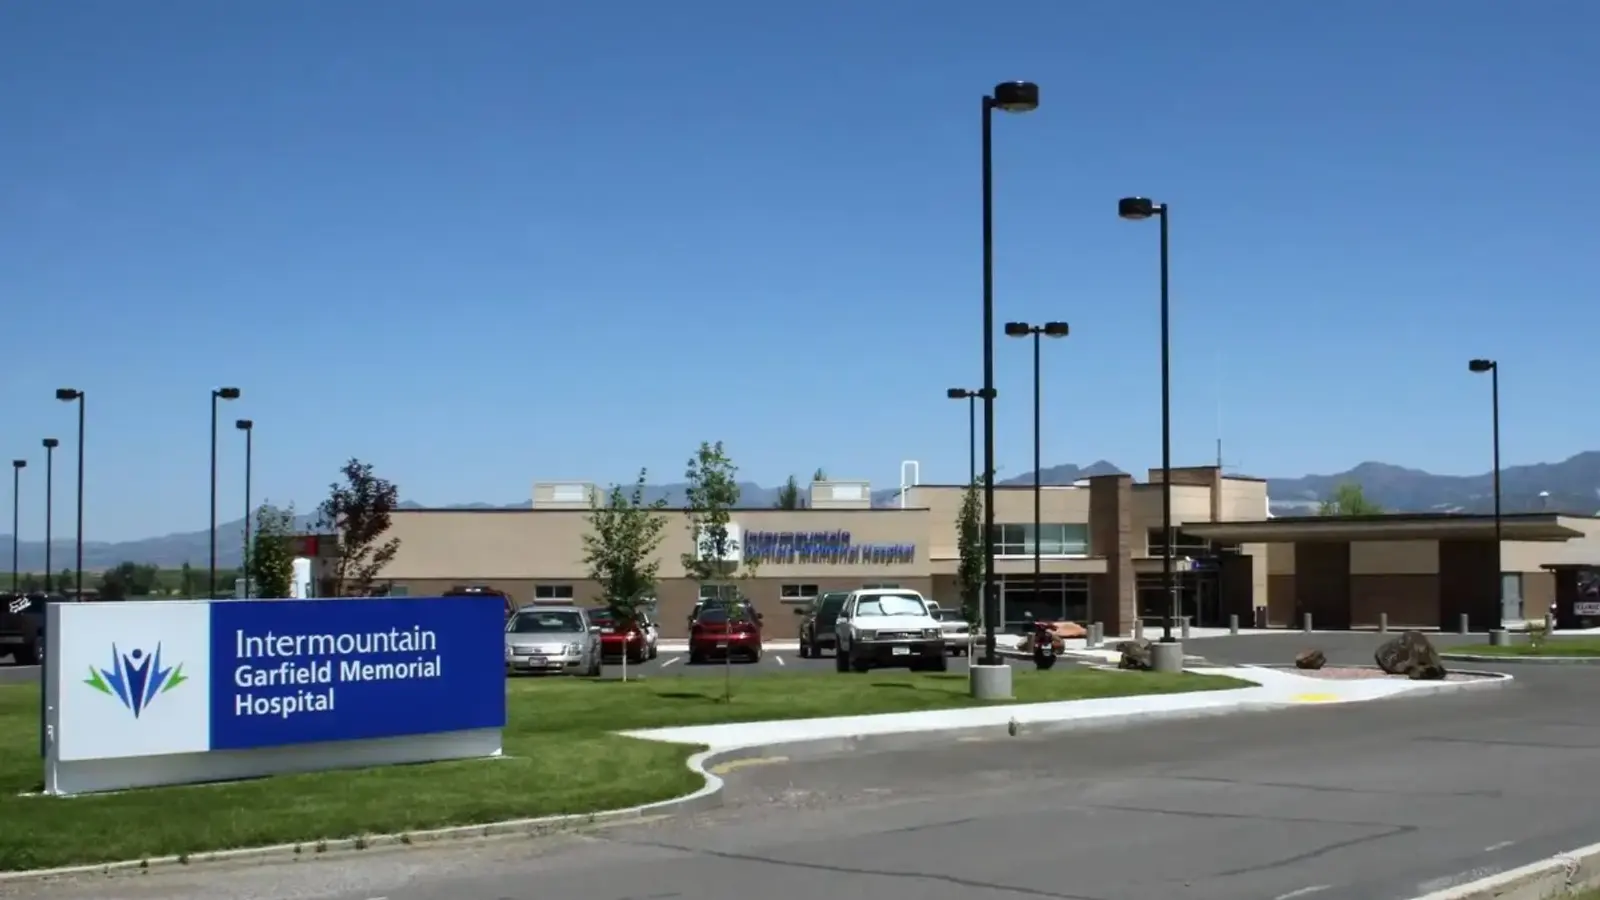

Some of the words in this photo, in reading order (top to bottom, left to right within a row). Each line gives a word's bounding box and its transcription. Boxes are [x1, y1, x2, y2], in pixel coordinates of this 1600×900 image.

[862, 544, 916, 567] Hospital
[235, 625, 437, 658] Intermountain
[234, 661, 332, 688] Garfield
[340, 654, 442, 682] Memorial
[235, 687, 335, 719] Hospital
